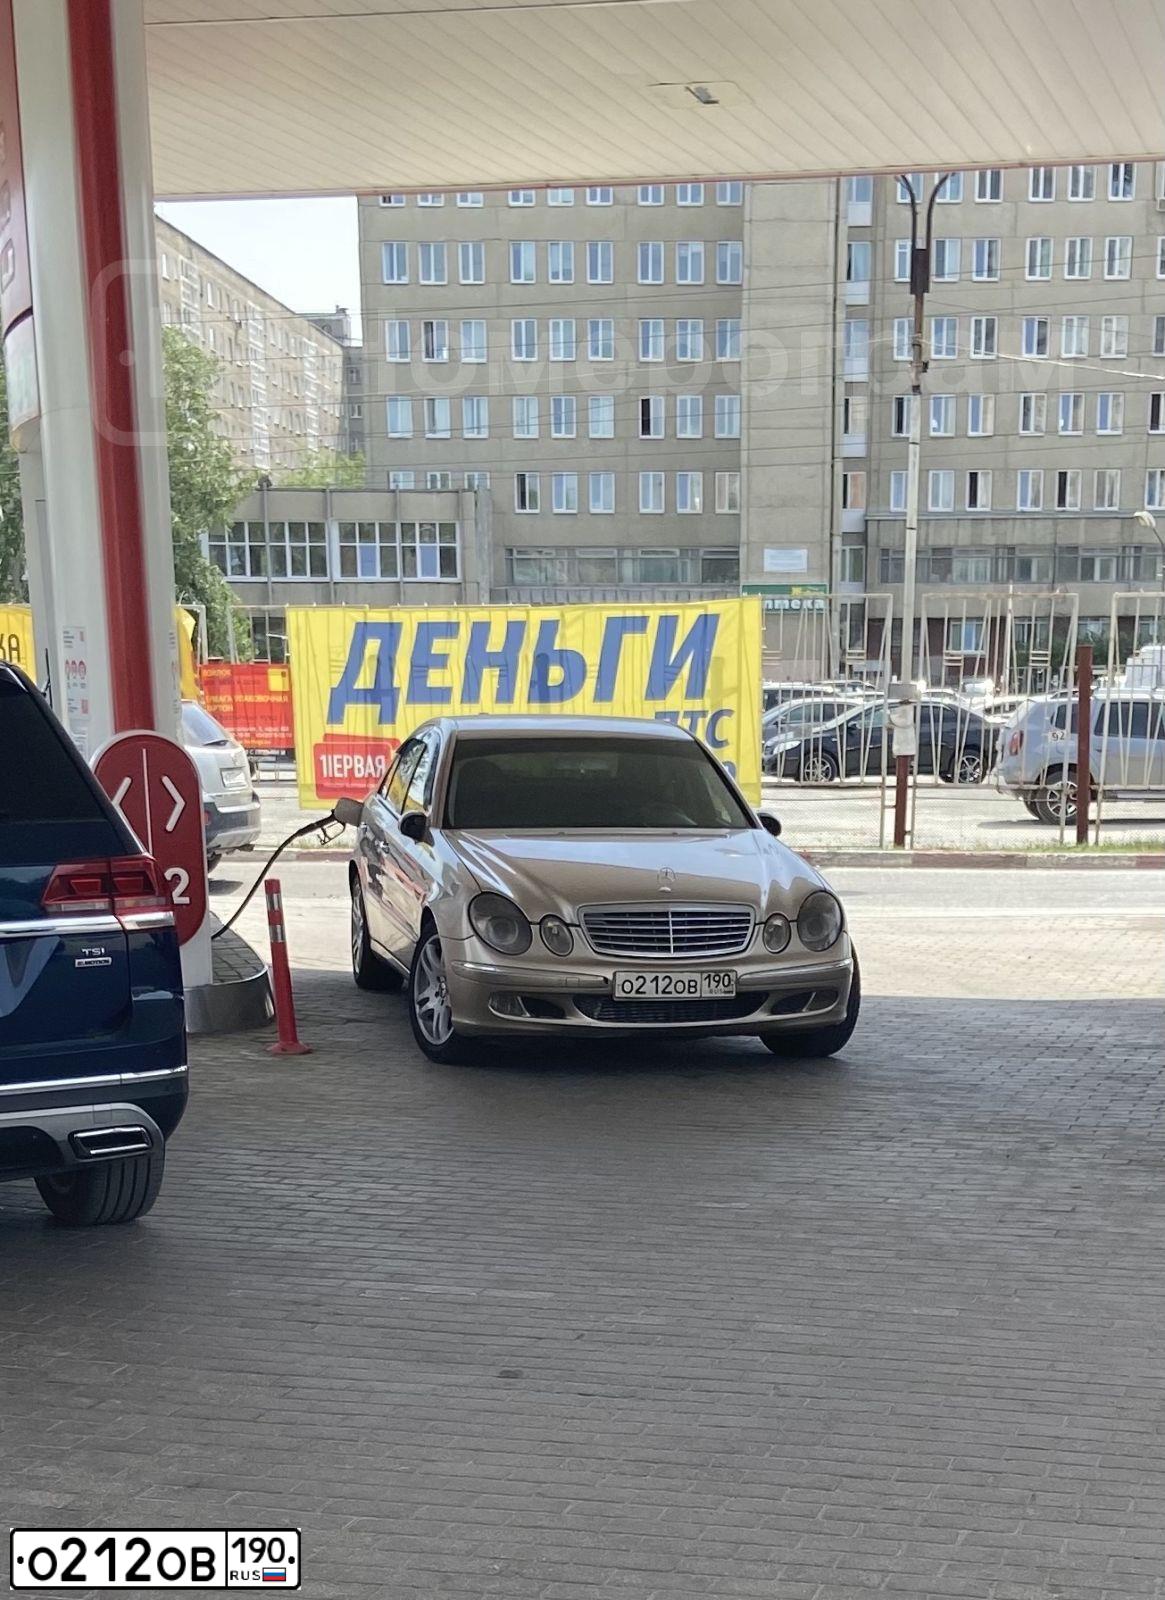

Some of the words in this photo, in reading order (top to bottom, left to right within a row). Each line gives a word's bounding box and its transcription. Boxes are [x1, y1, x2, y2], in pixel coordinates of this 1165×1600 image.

[763, 598, 825, 610] птека
[326, 612, 721, 725] ДЕНЬГИ
[163, 866, 191, 905] 2
[81, 947, 106, 956] TSI
[621, 975, 698, 995] О212ОВ
[704, 973, 731, 988] 190
